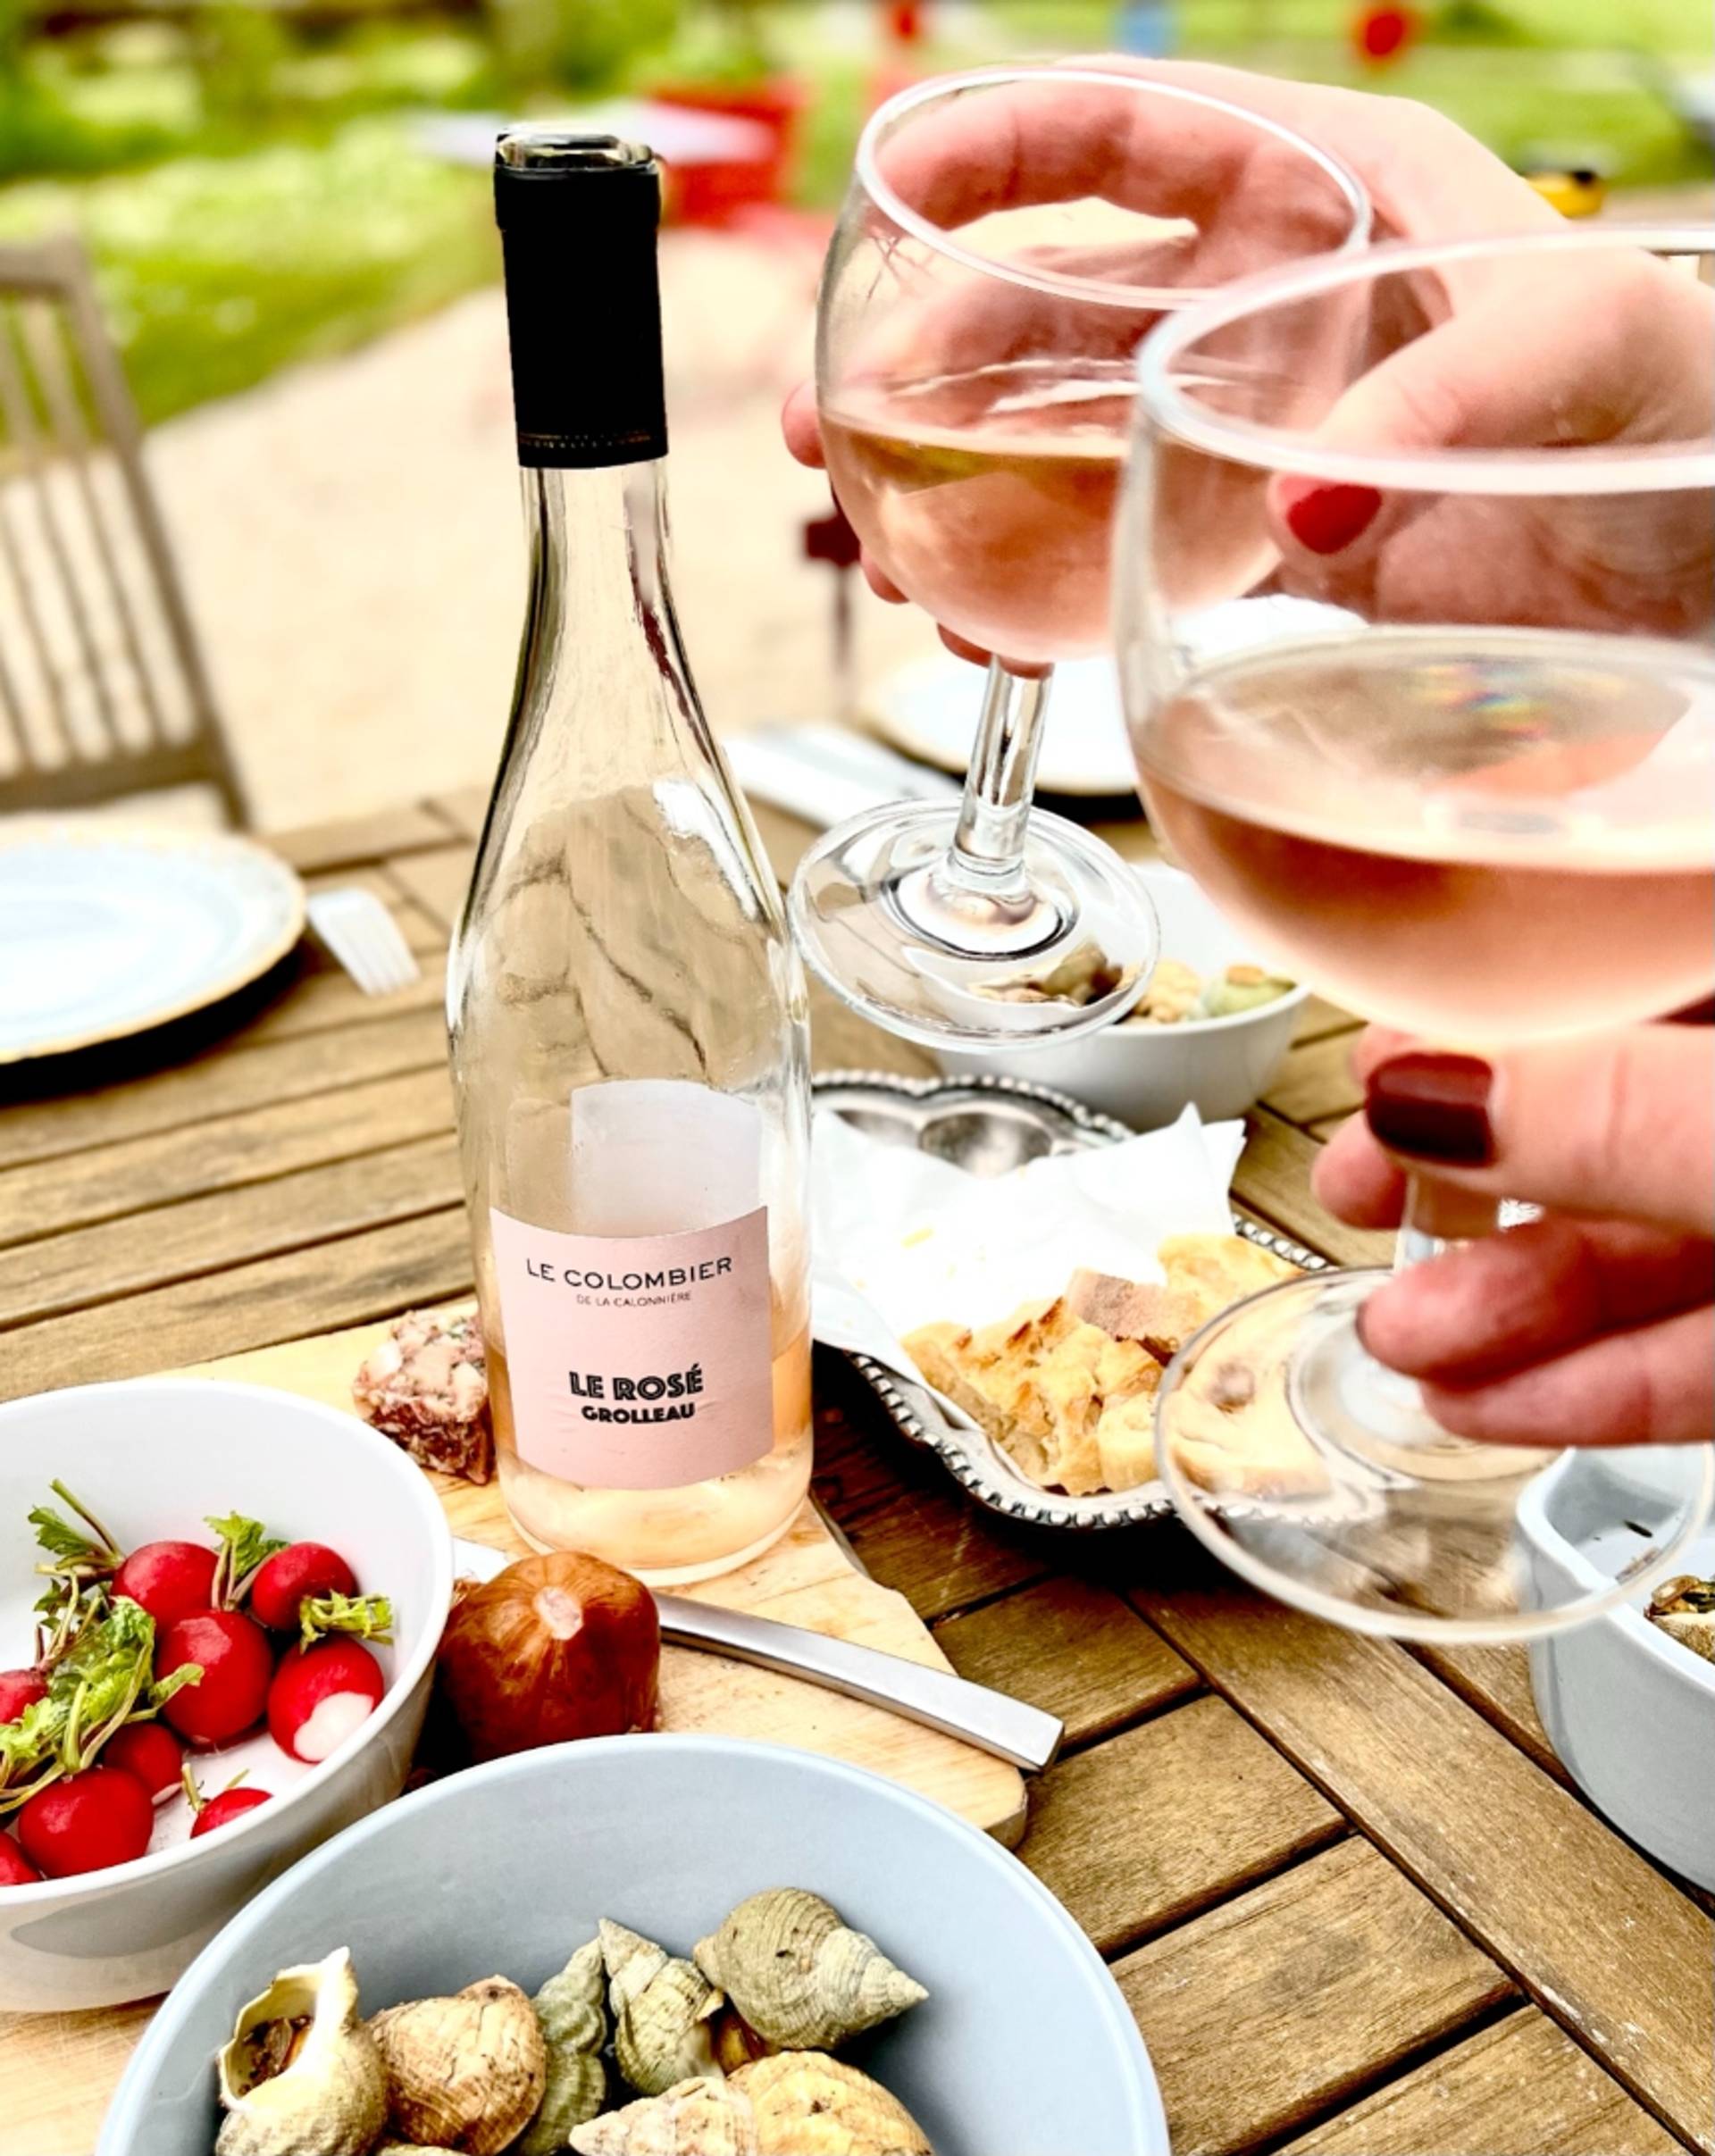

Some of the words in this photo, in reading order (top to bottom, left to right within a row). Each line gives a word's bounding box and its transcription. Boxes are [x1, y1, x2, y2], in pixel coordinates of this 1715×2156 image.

[527, 1258, 555, 1282] LE
[564, 1257, 732, 1291] COLOMBIER
[577, 1293, 591, 1305] DE
[596, 1297, 610, 1307] LA
[569, 1371, 604, 1399] LE
[613, 1363, 704, 1401] ROSÉ
[581, 1403, 695, 1425] GROLLEAU
